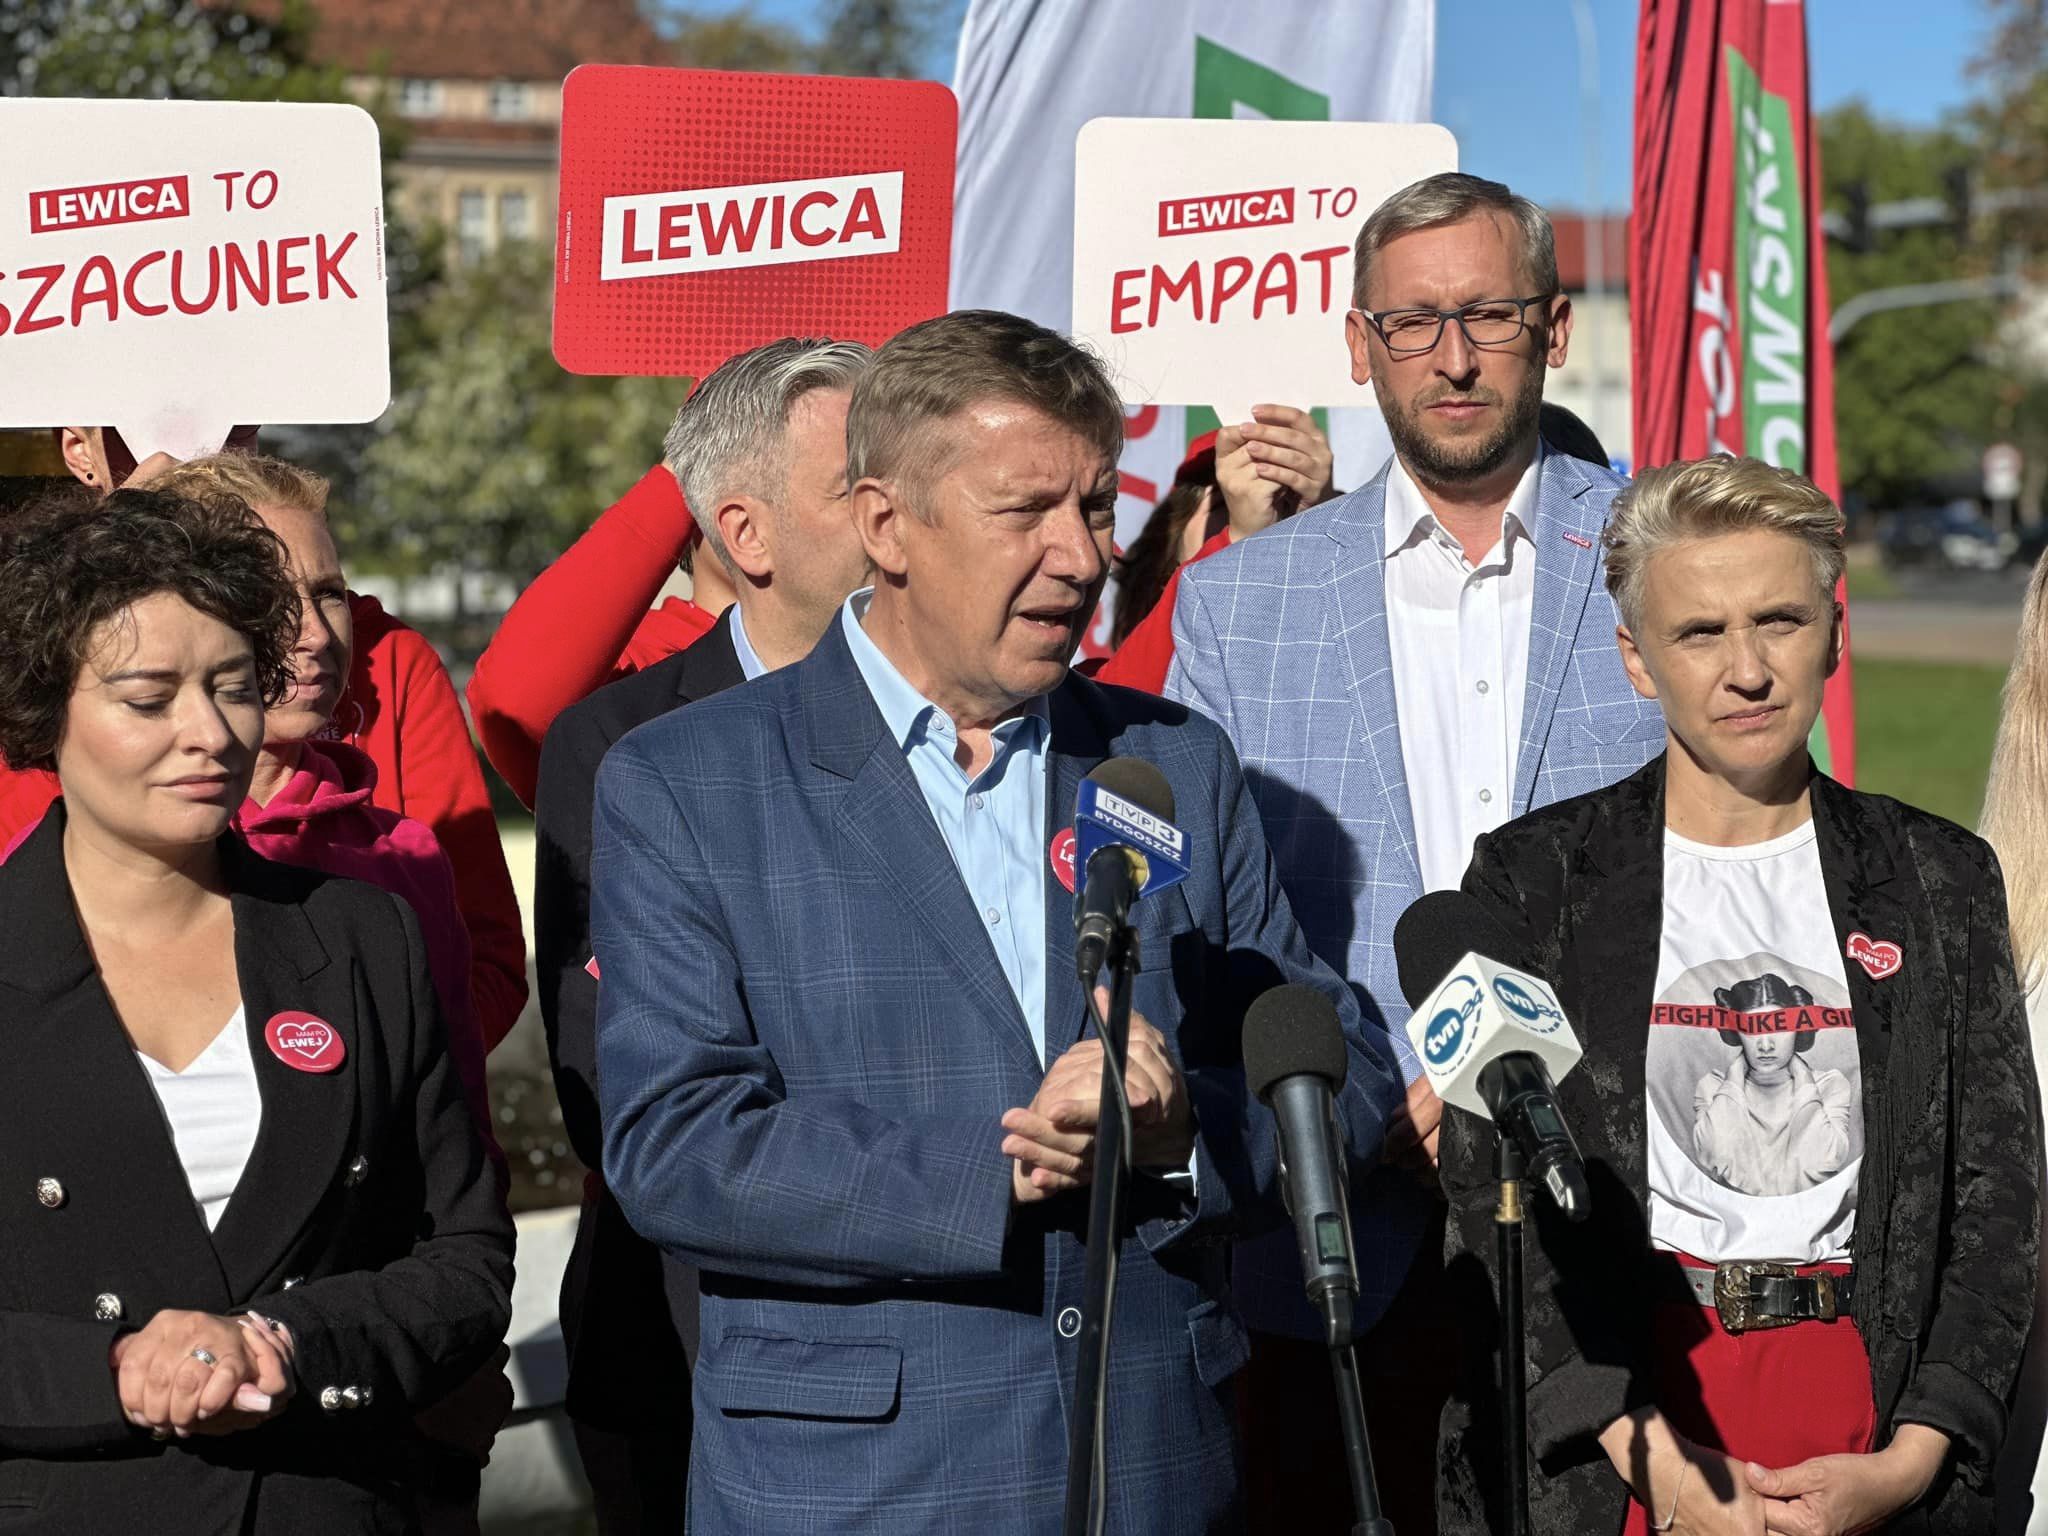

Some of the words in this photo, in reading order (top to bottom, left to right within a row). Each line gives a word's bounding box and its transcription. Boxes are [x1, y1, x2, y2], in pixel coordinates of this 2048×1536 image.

[39, 184, 182, 226] LEWICA
[213, 170, 278, 211] TO
[1166, 195, 1287, 231] LEWICA
[1308, 187, 1357, 219] TO
[622, 187, 885, 264] LEWICA
[0, 231, 358, 337] ZACUNEK
[1110, 245, 1351, 334] EMPAT
[1095, 810, 1181, 861] BYDGOSZCZ
[1849, 946, 1889, 970] LEWEJ
[279, 1037, 323, 1048] LEWEJ
[1654, 1006, 1729, 1027] FIGHT
[1735, 1011, 1787, 1033] LIKE
[1795, 1010, 1814, 1029] A
